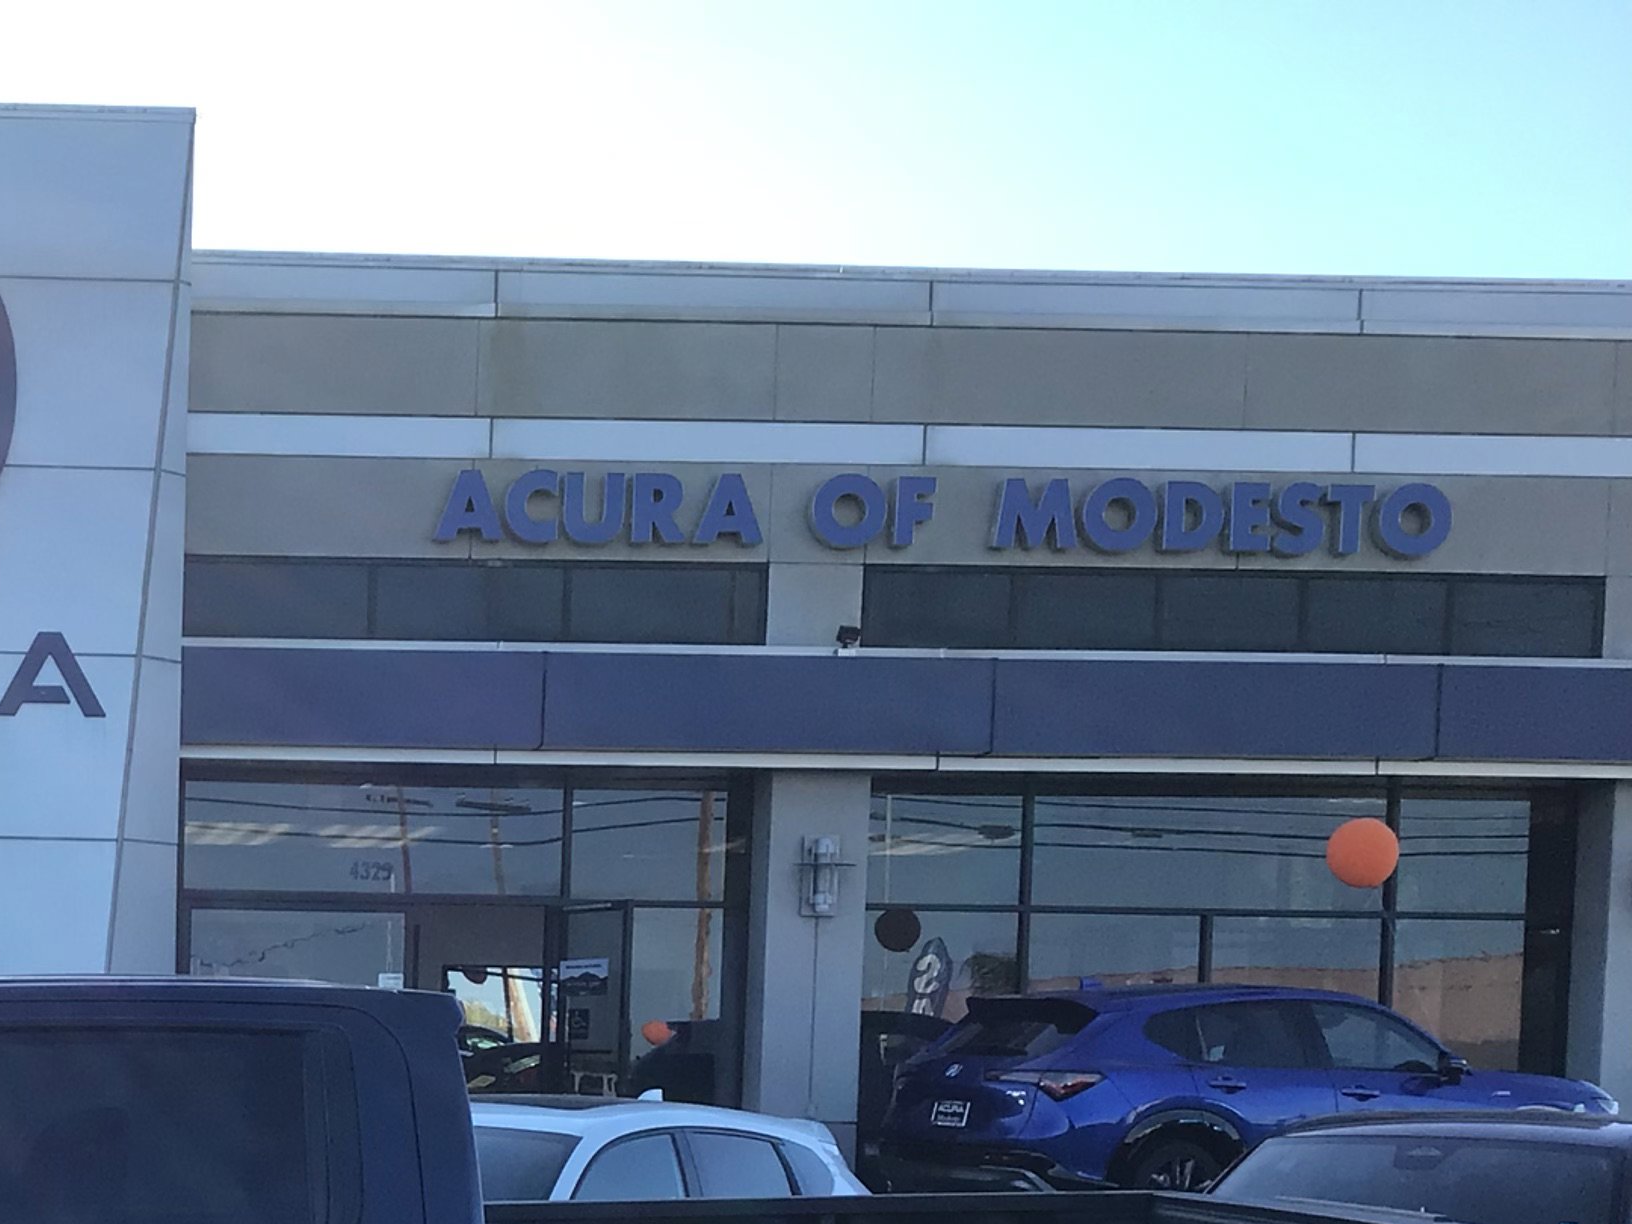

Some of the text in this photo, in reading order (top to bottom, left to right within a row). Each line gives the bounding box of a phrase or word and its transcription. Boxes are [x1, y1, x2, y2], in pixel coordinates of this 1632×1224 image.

[432, 468, 1455, 557] ACURA OF MODESTO
